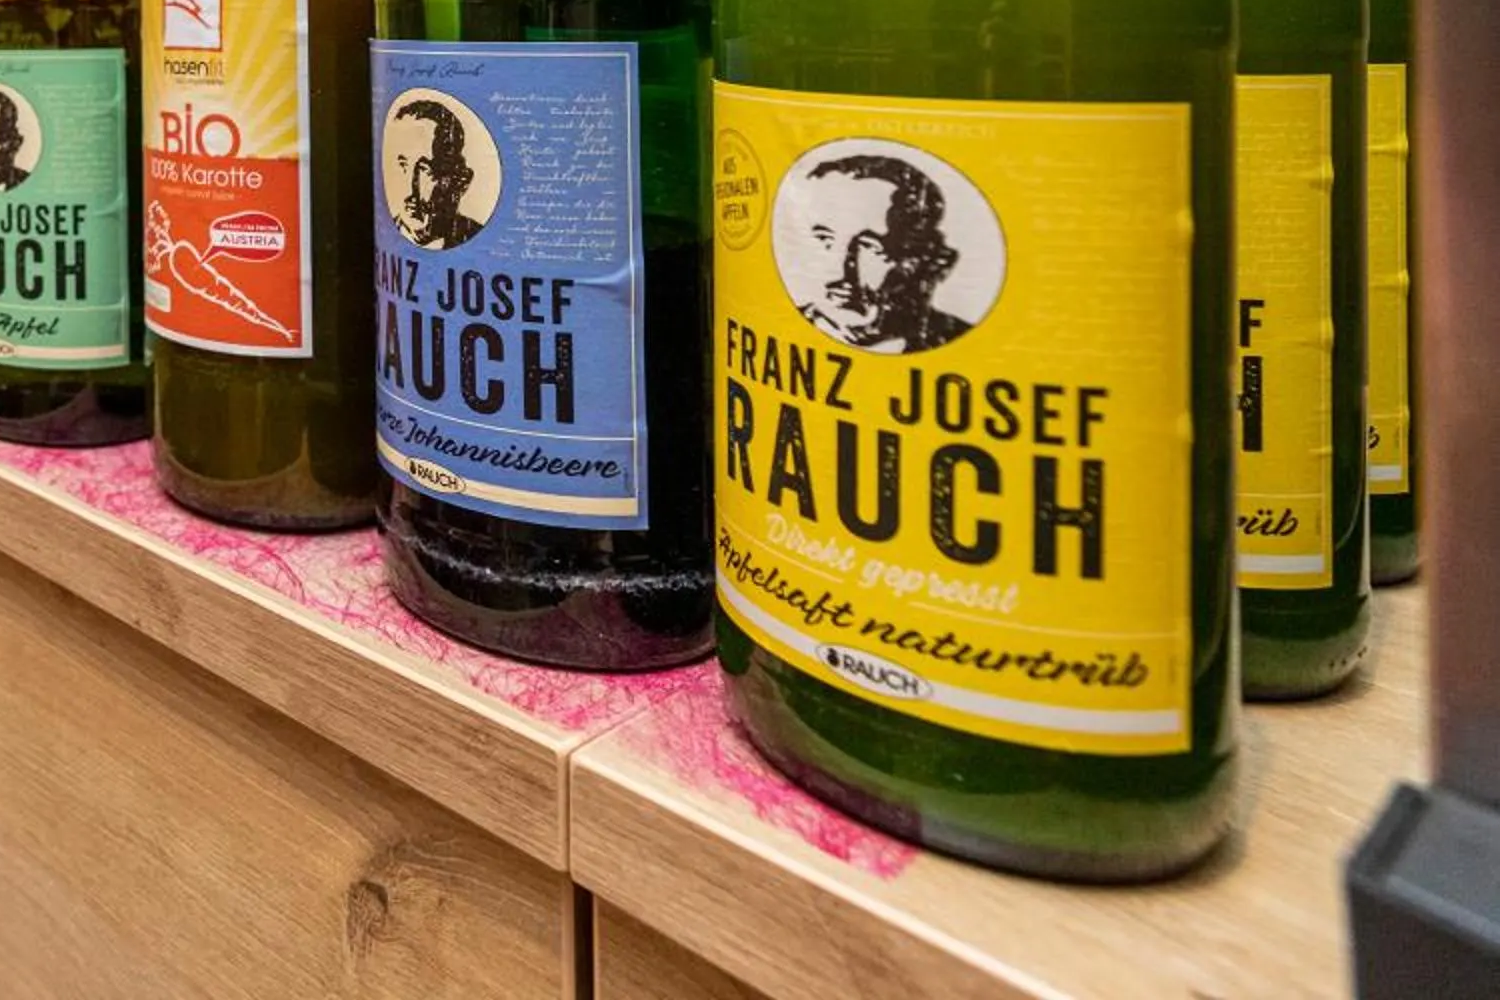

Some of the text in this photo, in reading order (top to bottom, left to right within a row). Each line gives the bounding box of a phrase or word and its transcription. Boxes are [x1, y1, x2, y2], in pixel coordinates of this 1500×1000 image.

[181, 163, 264, 189] Karotte
[1, 203, 86, 236] JOSEF
[220, 233, 280, 247] AUSTRIA
[437, 267, 575, 325] JOSEF
[378, 301, 575, 424] AUCH
[726, 316, 1111, 448] FRANZ JOSEF
[404, 415, 621, 479] Johannisbeere
[417, 463, 460, 491] RAUCH
[726, 375, 1106, 581] RAUCH
[718, 526, 1149, 690] Apfelsaft naturtrüb
[840, 651, 920, 698] RAUCH
